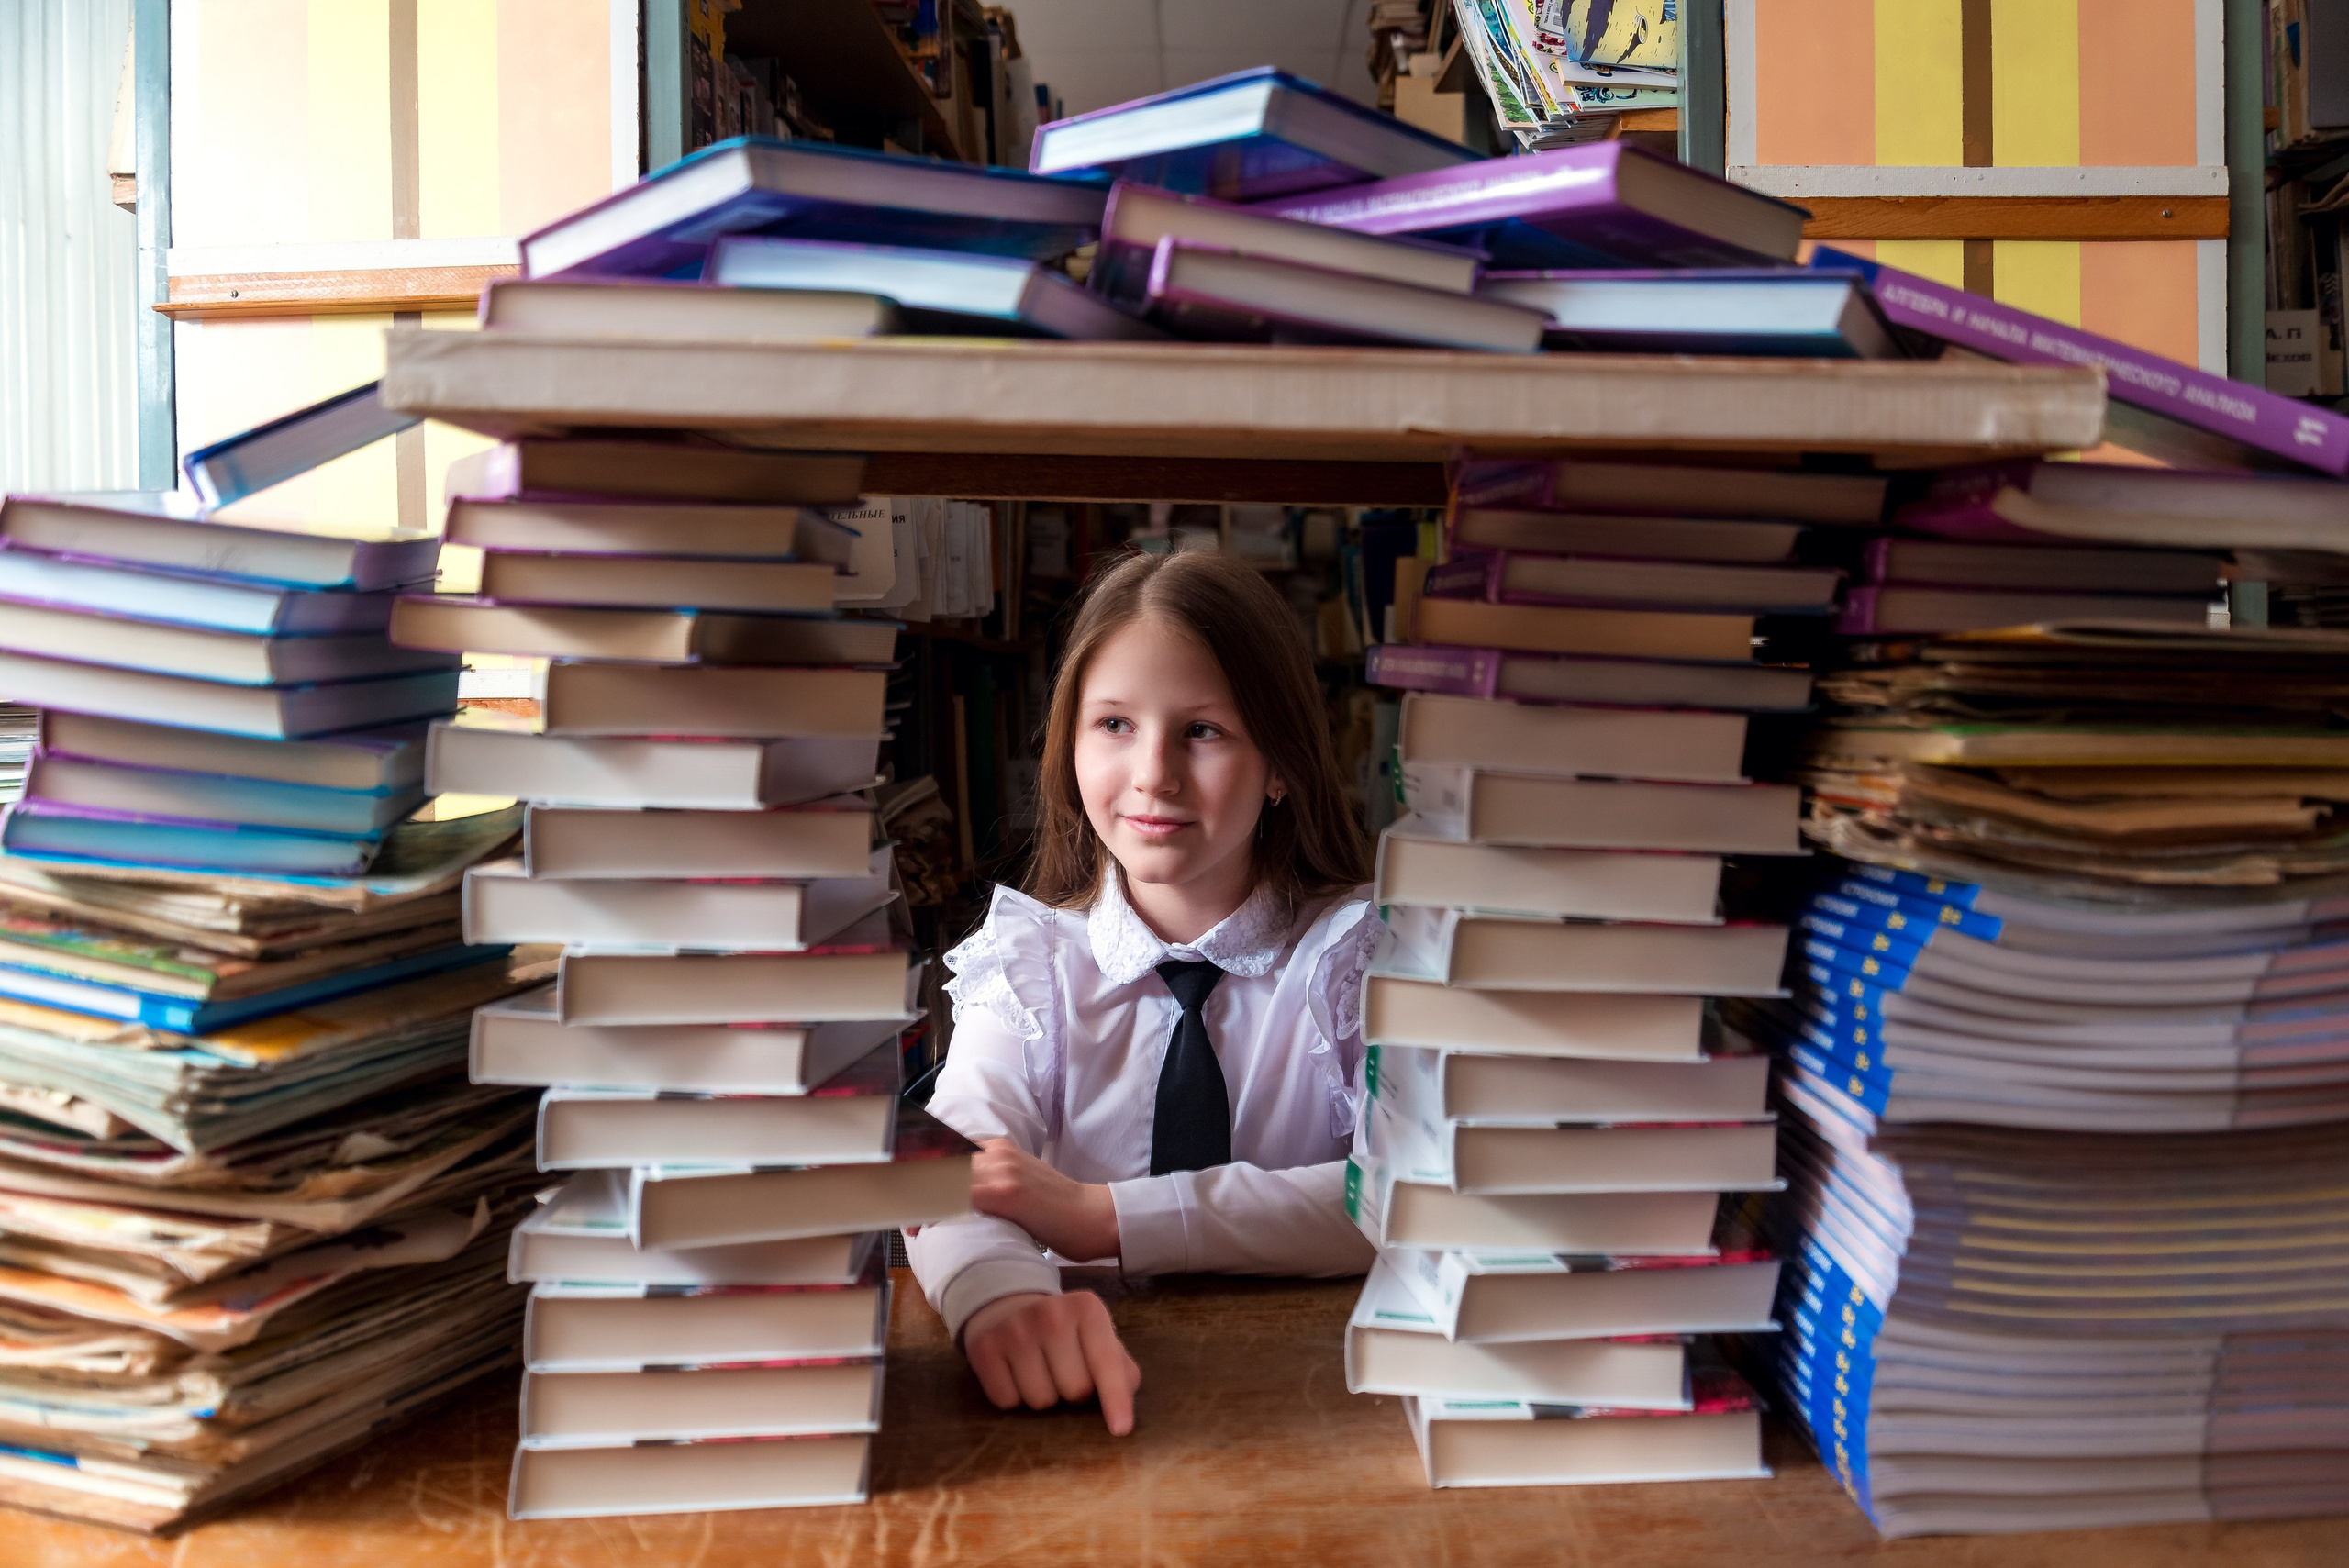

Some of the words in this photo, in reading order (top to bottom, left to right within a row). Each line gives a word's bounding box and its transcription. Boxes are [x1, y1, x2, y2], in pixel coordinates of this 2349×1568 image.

[1883, 283, 1949, 318] АЛГЕБРА
[1951, 305, 1967, 323] И
[1967, 311, 2029, 345] НАЧАЛА
[2183, 384, 2257, 424] АНАЛИЗА
